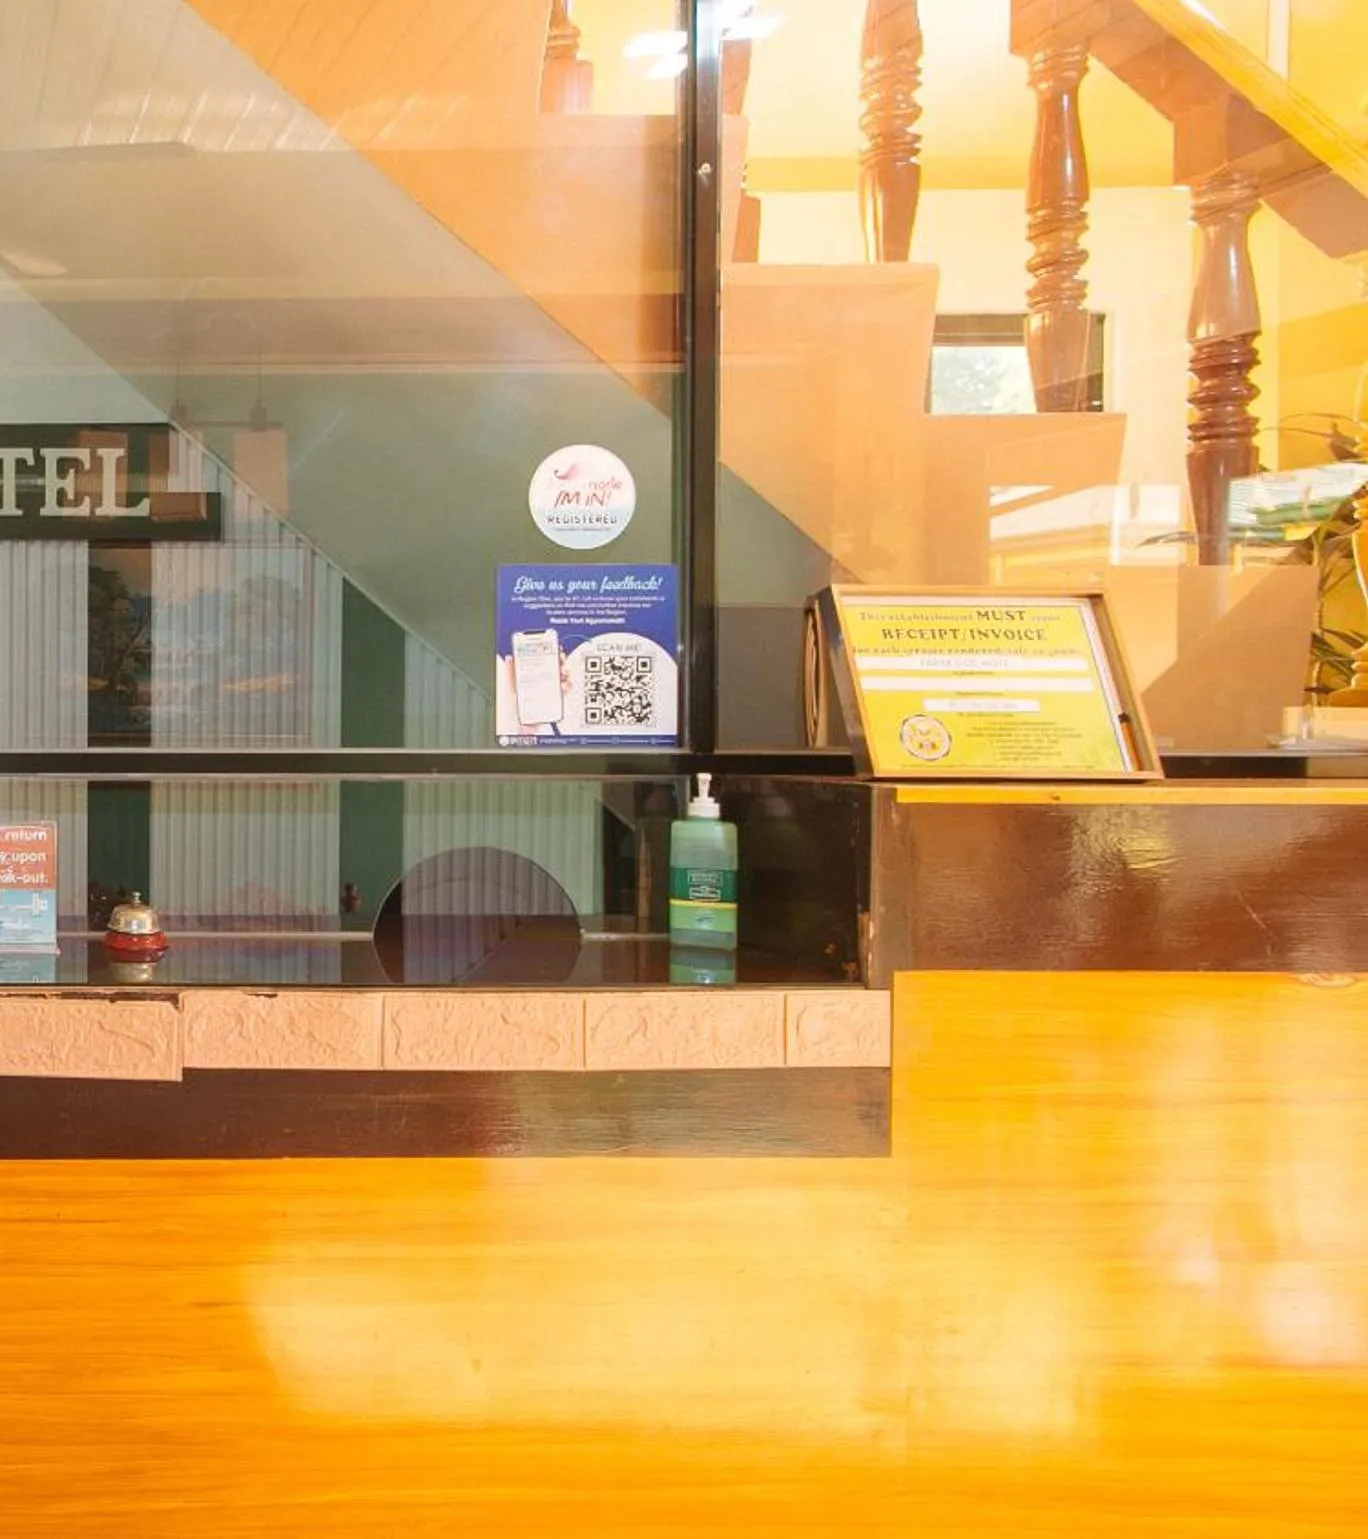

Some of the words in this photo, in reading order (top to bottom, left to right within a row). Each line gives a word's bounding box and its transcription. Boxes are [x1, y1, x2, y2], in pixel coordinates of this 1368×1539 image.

[546, 515, 618, 525] REGISTERED
[514, 575, 544, 593] Give
[548, 580, 564, 591] us
[567, 580, 597, 594] your
[599, 575, 664, 594] feedback!
[976, 610, 1026, 621] MUST
[5, 828, 47, 841] return
[12, 852, 47, 864] upon
